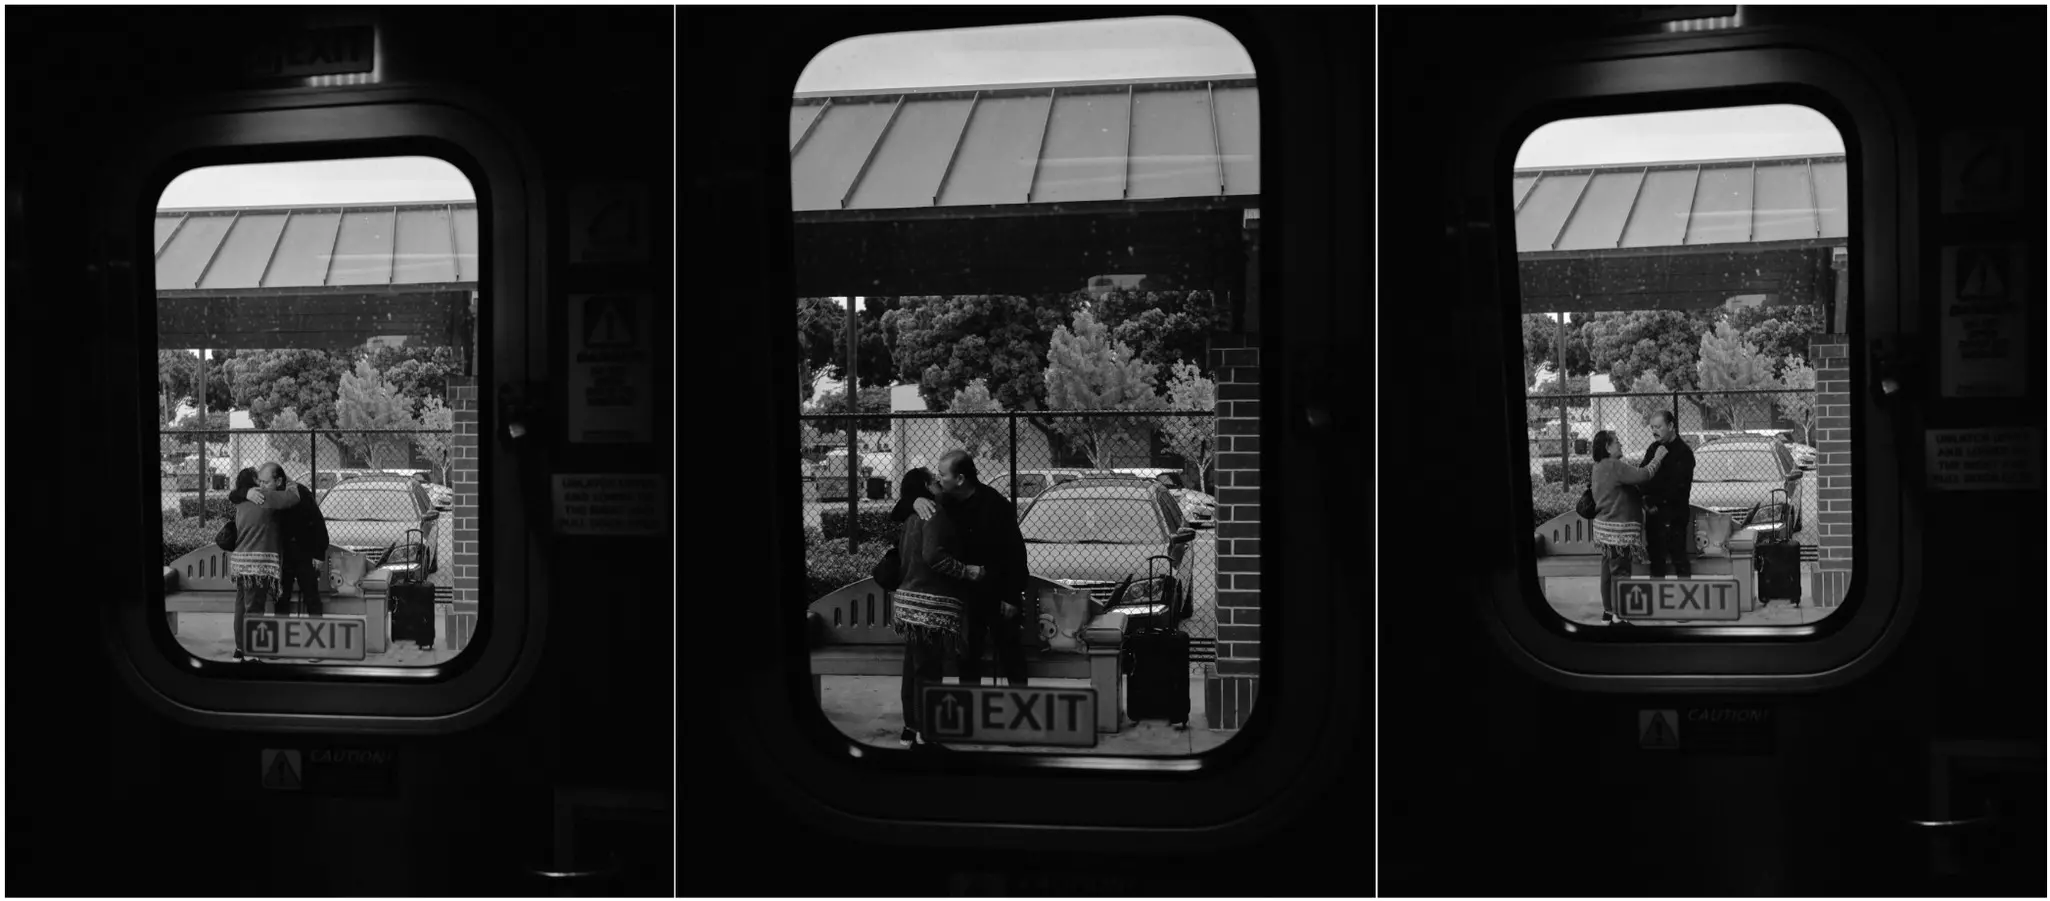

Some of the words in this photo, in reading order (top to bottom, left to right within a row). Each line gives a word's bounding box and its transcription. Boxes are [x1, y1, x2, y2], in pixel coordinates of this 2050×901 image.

[287, 30, 365, 65] EXIT
[1659, 583, 1732, 610] EXIT
[284, 621, 358, 649] EXIT
[981, 691, 1088, 732] EXIT
[1687, 707, 1769, 722] CAUTION!
[309, 748, 392, 764] CAUTION!
